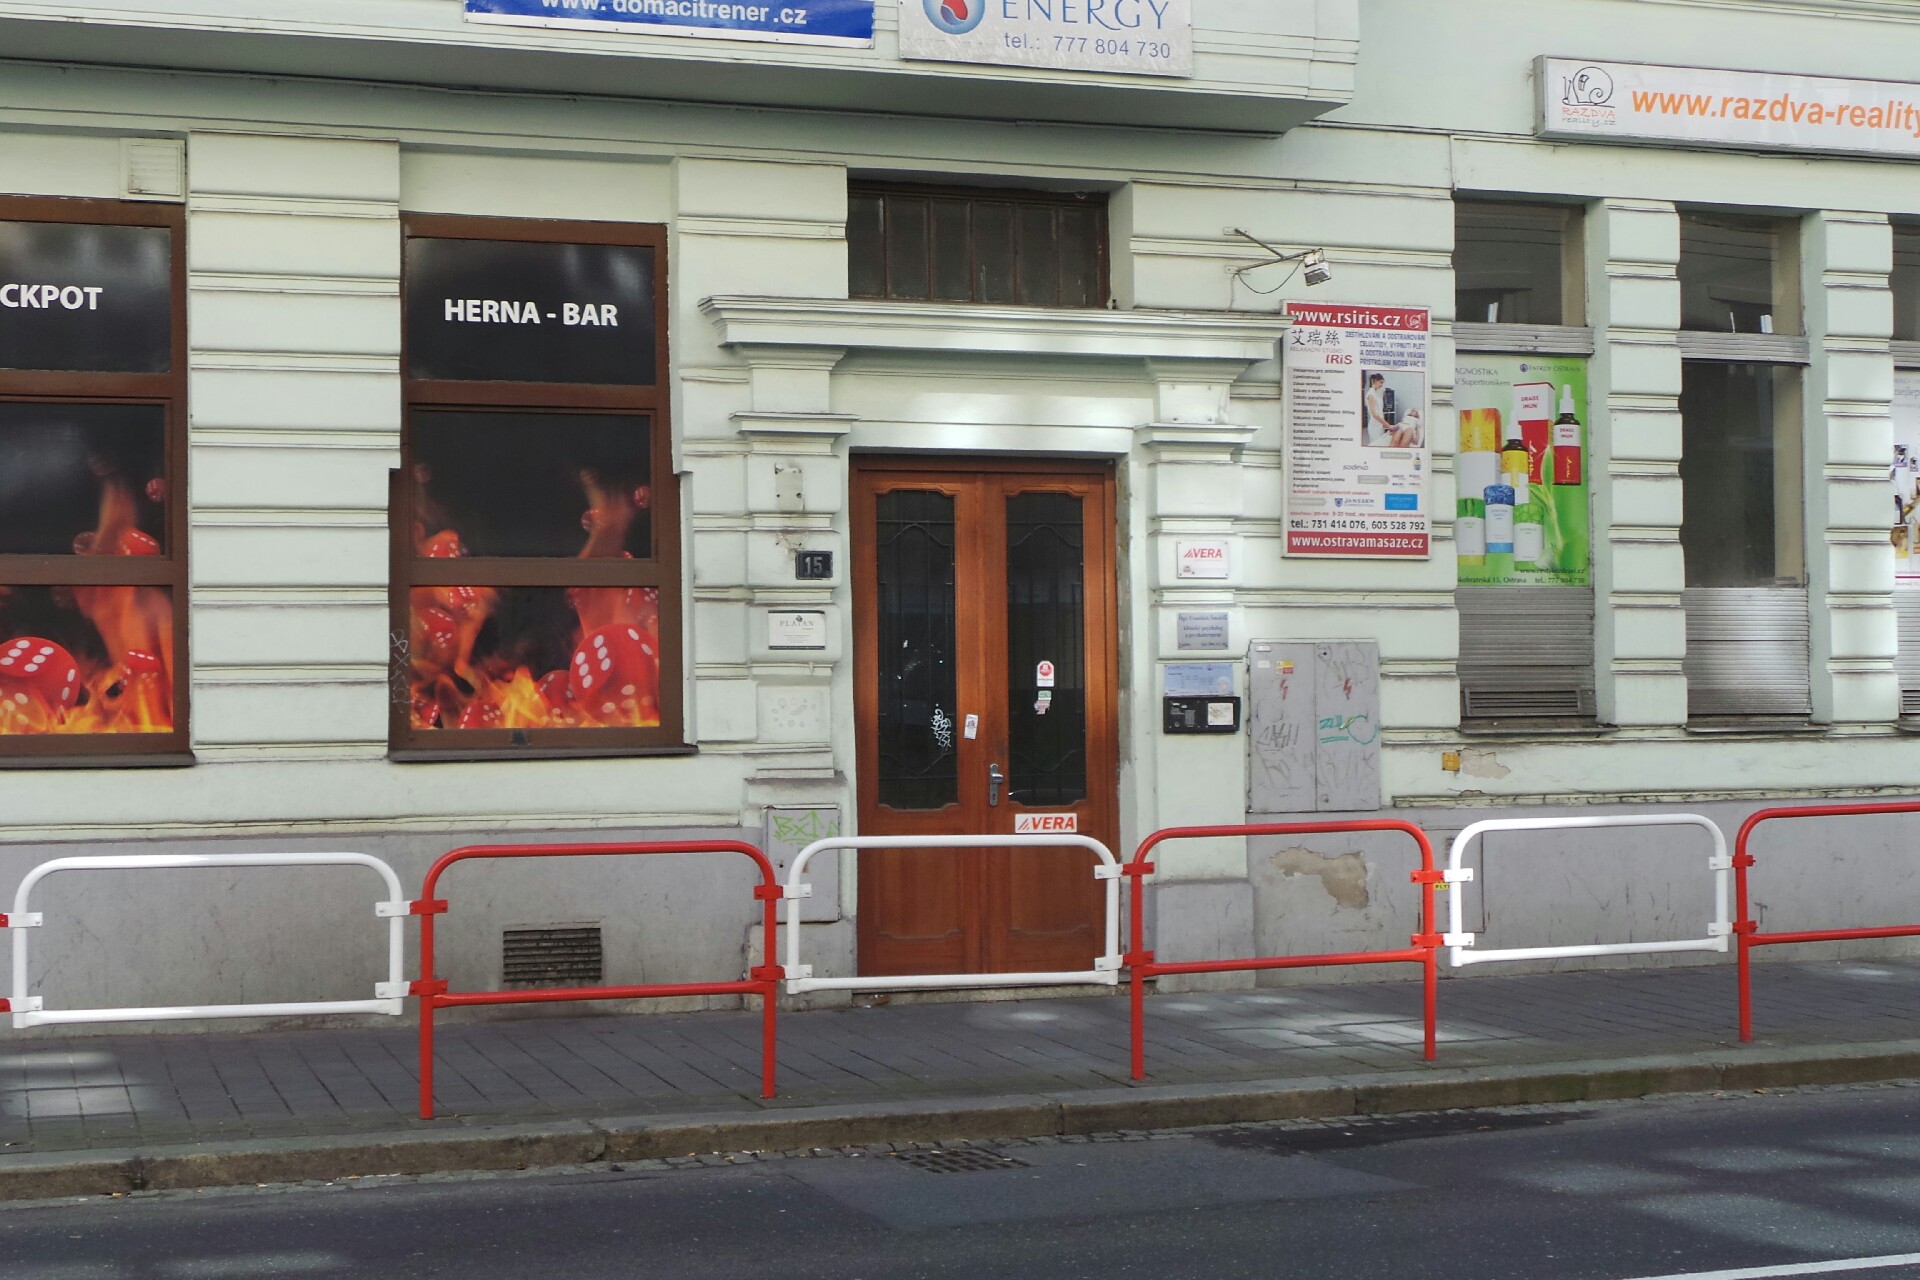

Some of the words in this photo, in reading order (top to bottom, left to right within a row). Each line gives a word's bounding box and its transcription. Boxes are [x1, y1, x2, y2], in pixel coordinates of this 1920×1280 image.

[1002, 0, 1169, 31] ENERGY
[1004, 32, 1040, 50] tel.:
[1053, 36, 1088, 53] 777
[1095, 38, 1130, 55] 804
[1137, 41, 1171, 59] 730
[1562, 107, 1616, 118] RAZDVA
[0, 283, 103, 310] CKPOT
[445, 298, 541, 324] HERNA
[563, 303, 618, 327] BAR
[1290, 310, 1401, 327] www.rsiris.cz
[1291, 519, 1309, 529] tel.:
[1312, 519, 1327, 529] 731
[1331, 519, 1347, 529] 414
[1350, 520, 1369, 531] 076,
[1371, 520, 1388, 530] 603
[1391, 521, 1407, 530] 528
[1409, 521, 1426, 531] 792
[1292, 536, 1424, 549] www.ostravamasaze.cz
[805, 556, 823, 576] 15
